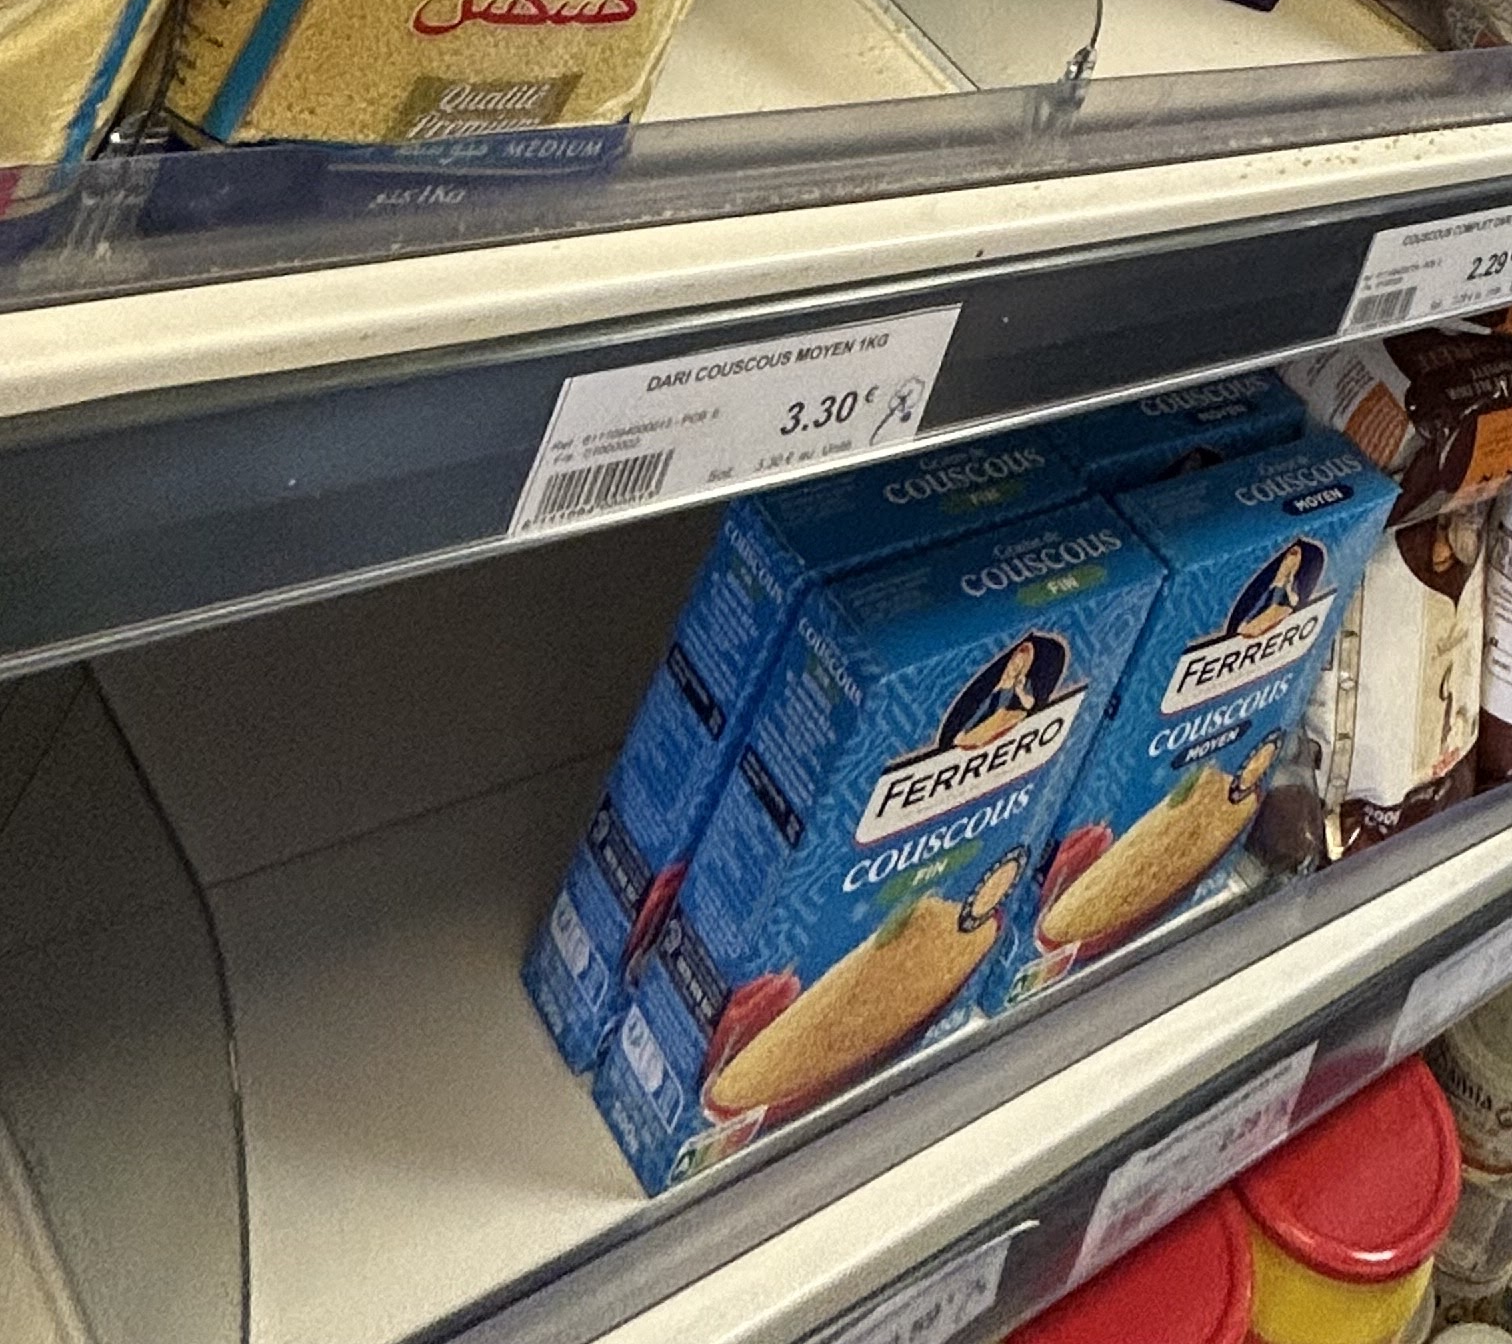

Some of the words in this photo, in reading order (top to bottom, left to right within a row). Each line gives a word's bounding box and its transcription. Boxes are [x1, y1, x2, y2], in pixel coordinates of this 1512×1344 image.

[1465, 250, 1508, 282] 2.29
[646, 369, 693, 393] DARI
[694, 351, 793, 383] COUSCOUS
[795, 341, 854, 364] MOYEN
[858, 332, 891, 355] 1KG
[780, 389, 859, 437] 3.30
[882, 446, 1047, 506] COUSCOUS
[1234, 452, 1364, 509] COUSCOUS
[1293, 487, 1343, 513] MOYEN
[960, 523, 1124, 603] COUSCOUS
[1046, 573, 1081, 600] FIN
[1175, 612, 1321, 696] FERRERO
[1146, 671, 1297, 760] COUSCOUS
[1183, 726, 1243, 763] MOYEN
[874, 714, 1068, 820] FERRERO
[840, 782, 1036, 895] COUSCOUS
[911, 859, 948, 887] FIN
